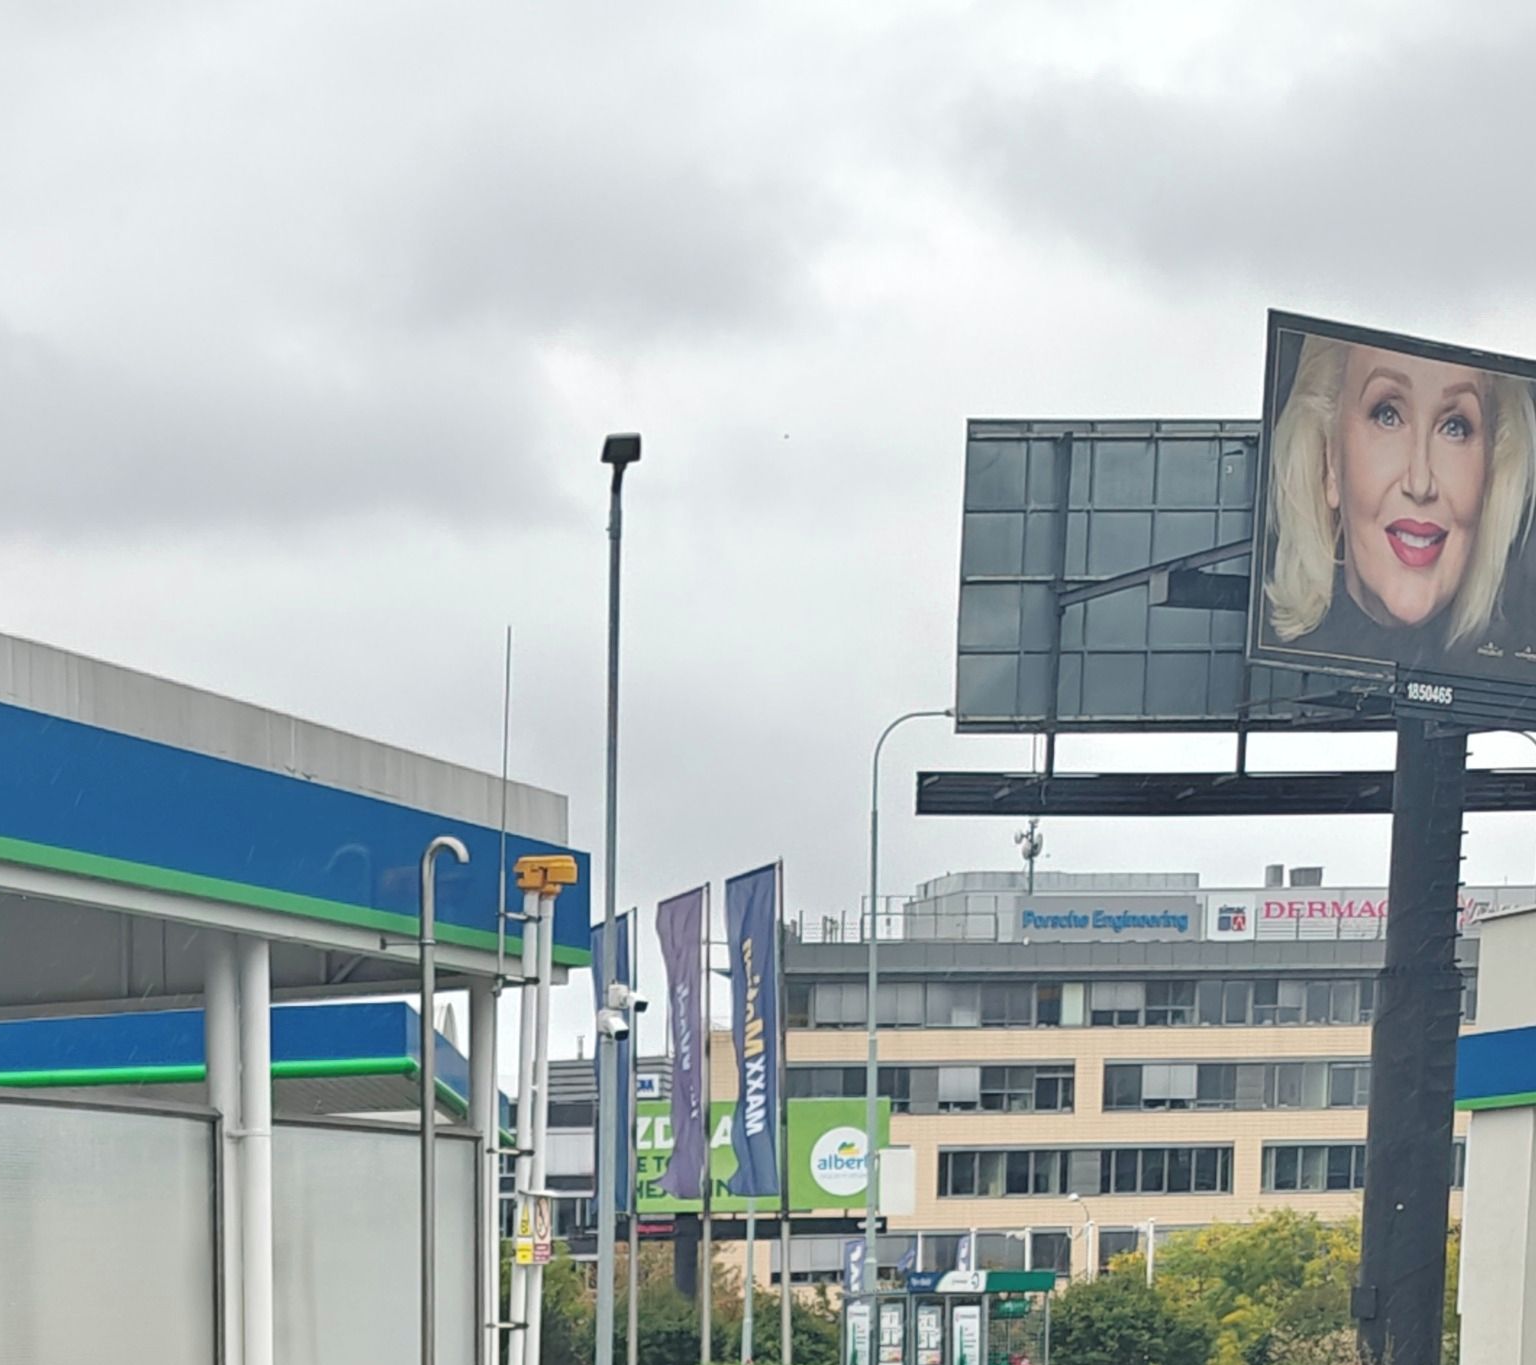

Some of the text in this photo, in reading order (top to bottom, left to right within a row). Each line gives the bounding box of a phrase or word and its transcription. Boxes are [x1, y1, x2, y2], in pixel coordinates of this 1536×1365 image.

[1407, 682, 1453, 704] 1850465
[1022, 910, 1189, 933] Porsche Engineering
